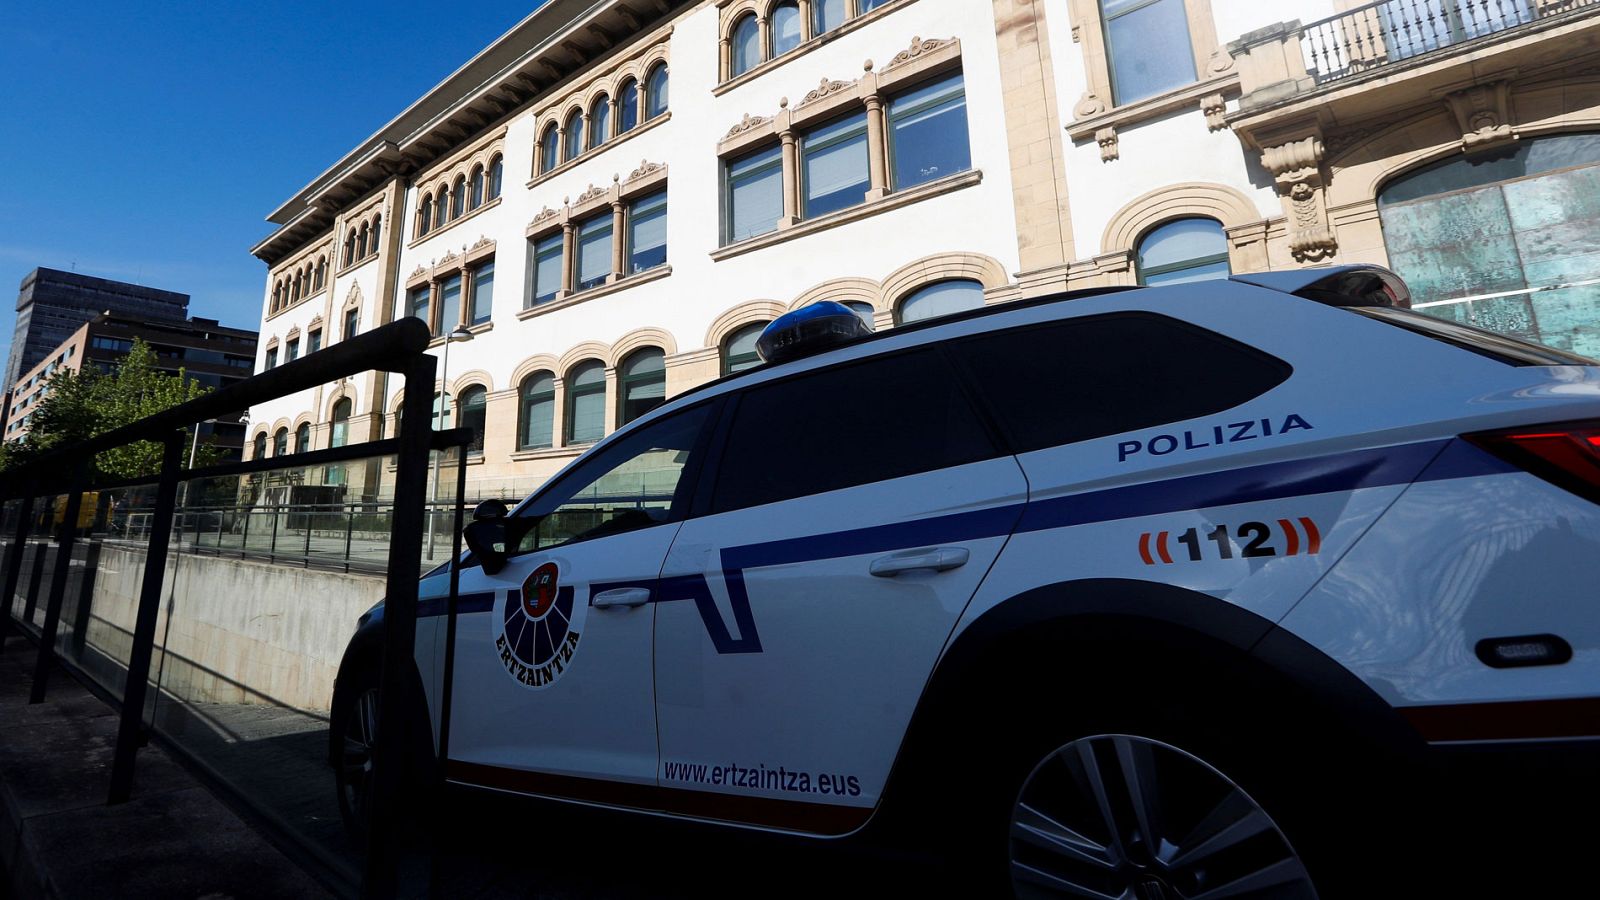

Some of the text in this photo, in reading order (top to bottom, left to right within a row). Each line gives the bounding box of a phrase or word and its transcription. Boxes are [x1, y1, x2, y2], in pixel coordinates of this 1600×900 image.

[1118, 414, 1314, 462] POLIZIA
[496, 631, 580, 687] ERTZAINTZA
[664, 761, 861, 796] www.ertzaintza.eus
